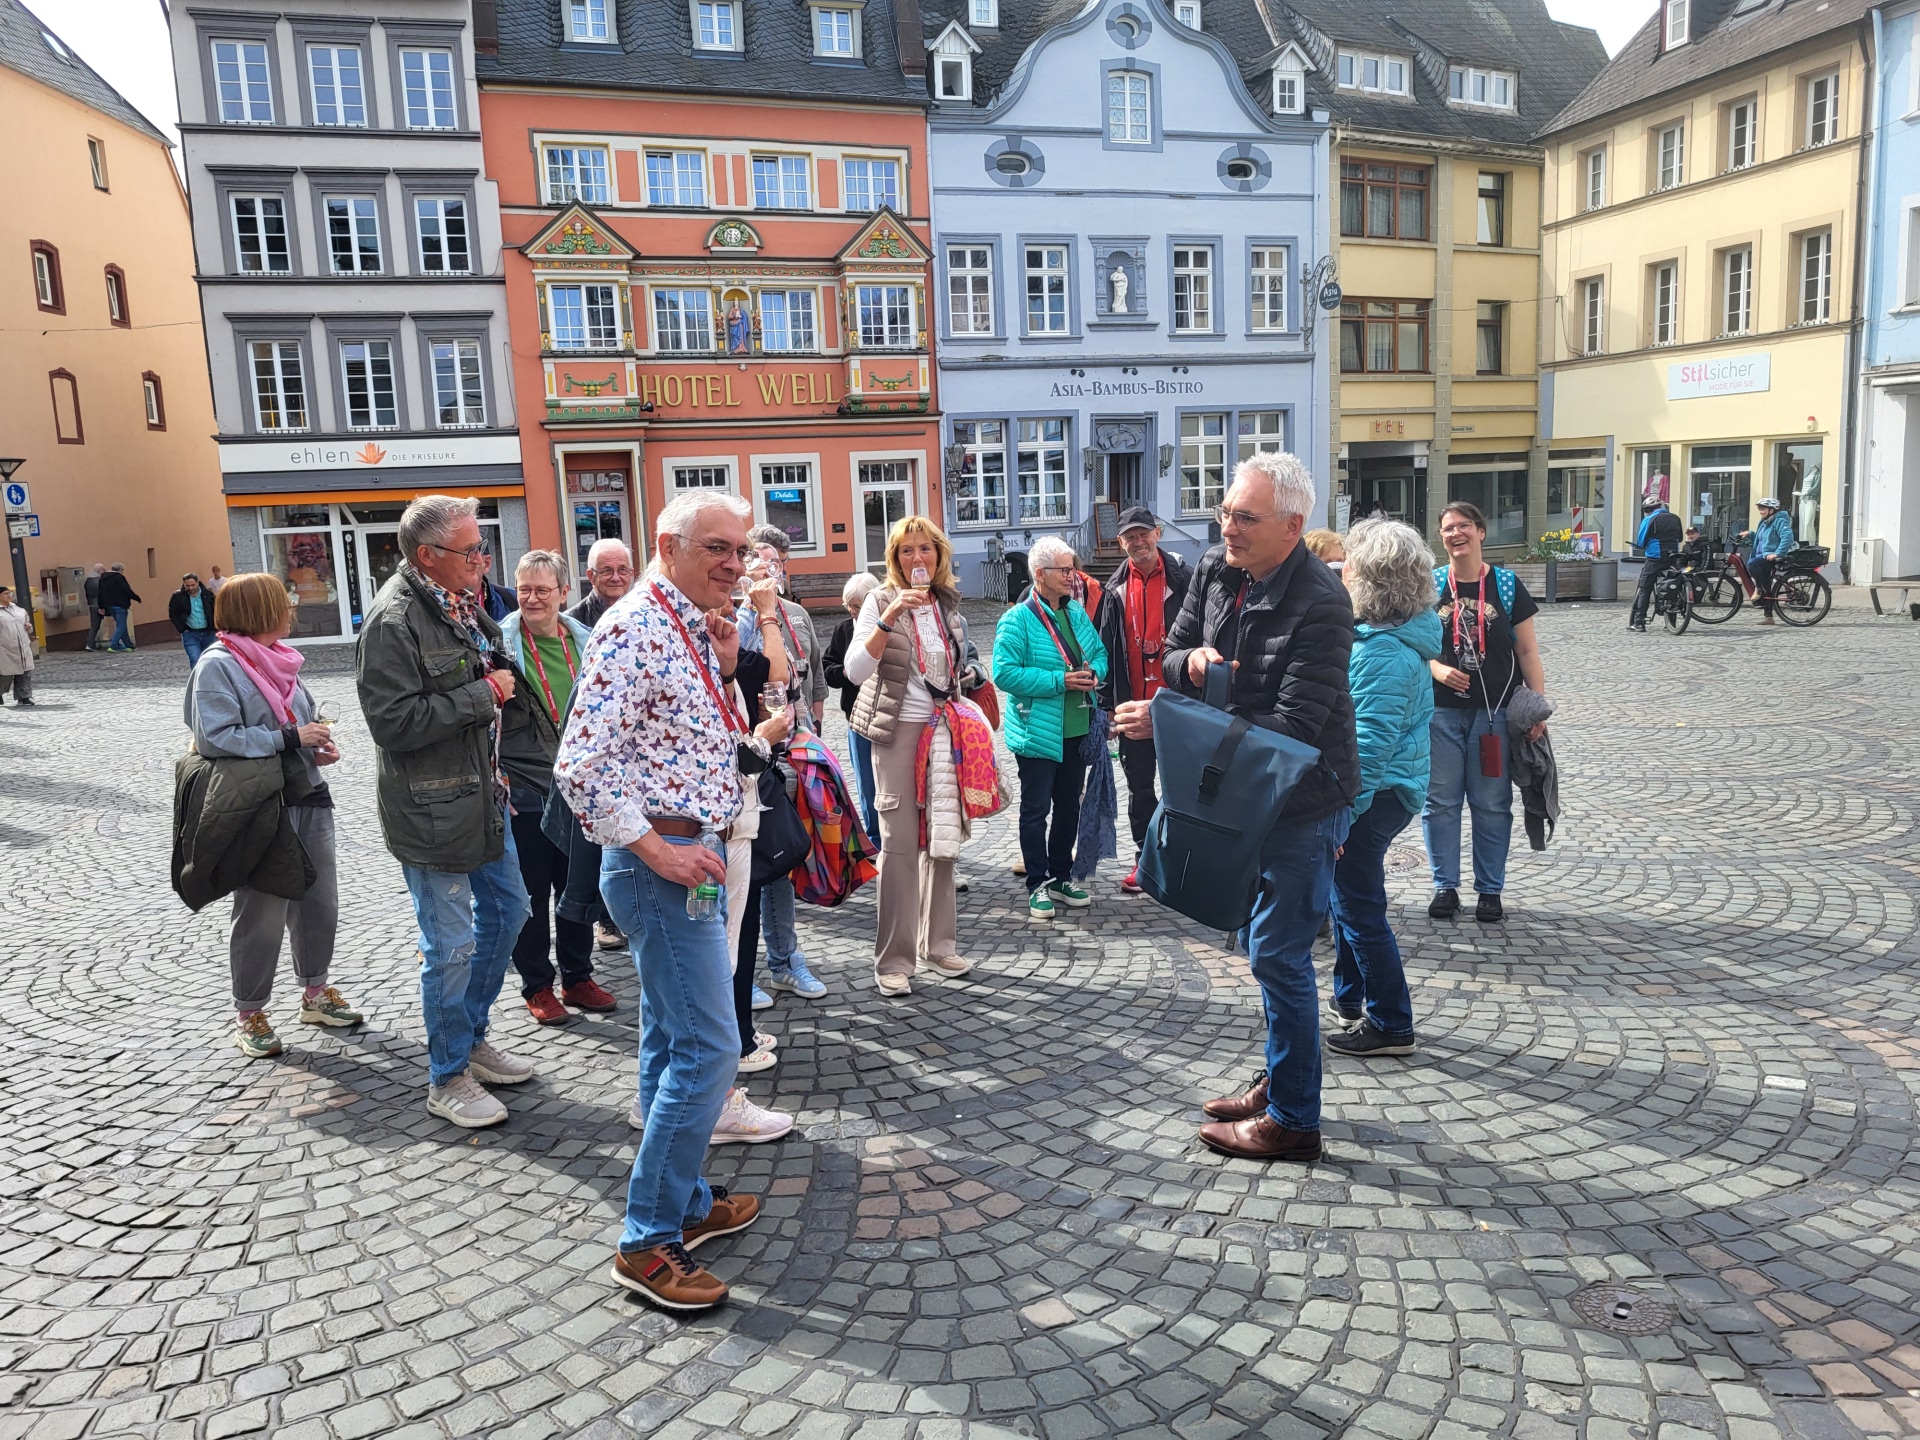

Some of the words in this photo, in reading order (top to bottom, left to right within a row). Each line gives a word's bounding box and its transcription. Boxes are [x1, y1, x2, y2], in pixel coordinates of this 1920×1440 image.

[1323, 285, 1338, 298] Asia
[1681, 361, 1754, 385] Stilsicher
[640, 374, 742, 407] HOTEL
[755, 373, 842, 405] WELL
[1709, 382, 1728, 391] MODE
[1729, 381, 1743, 389] FÜR
[1743, 380, 1754, 388] SIE
[290, 447, 350, 464] ehlen
[412, 452, 456, 461] FRISEURE
[346, 543, 358, 606] KOSMETIK
